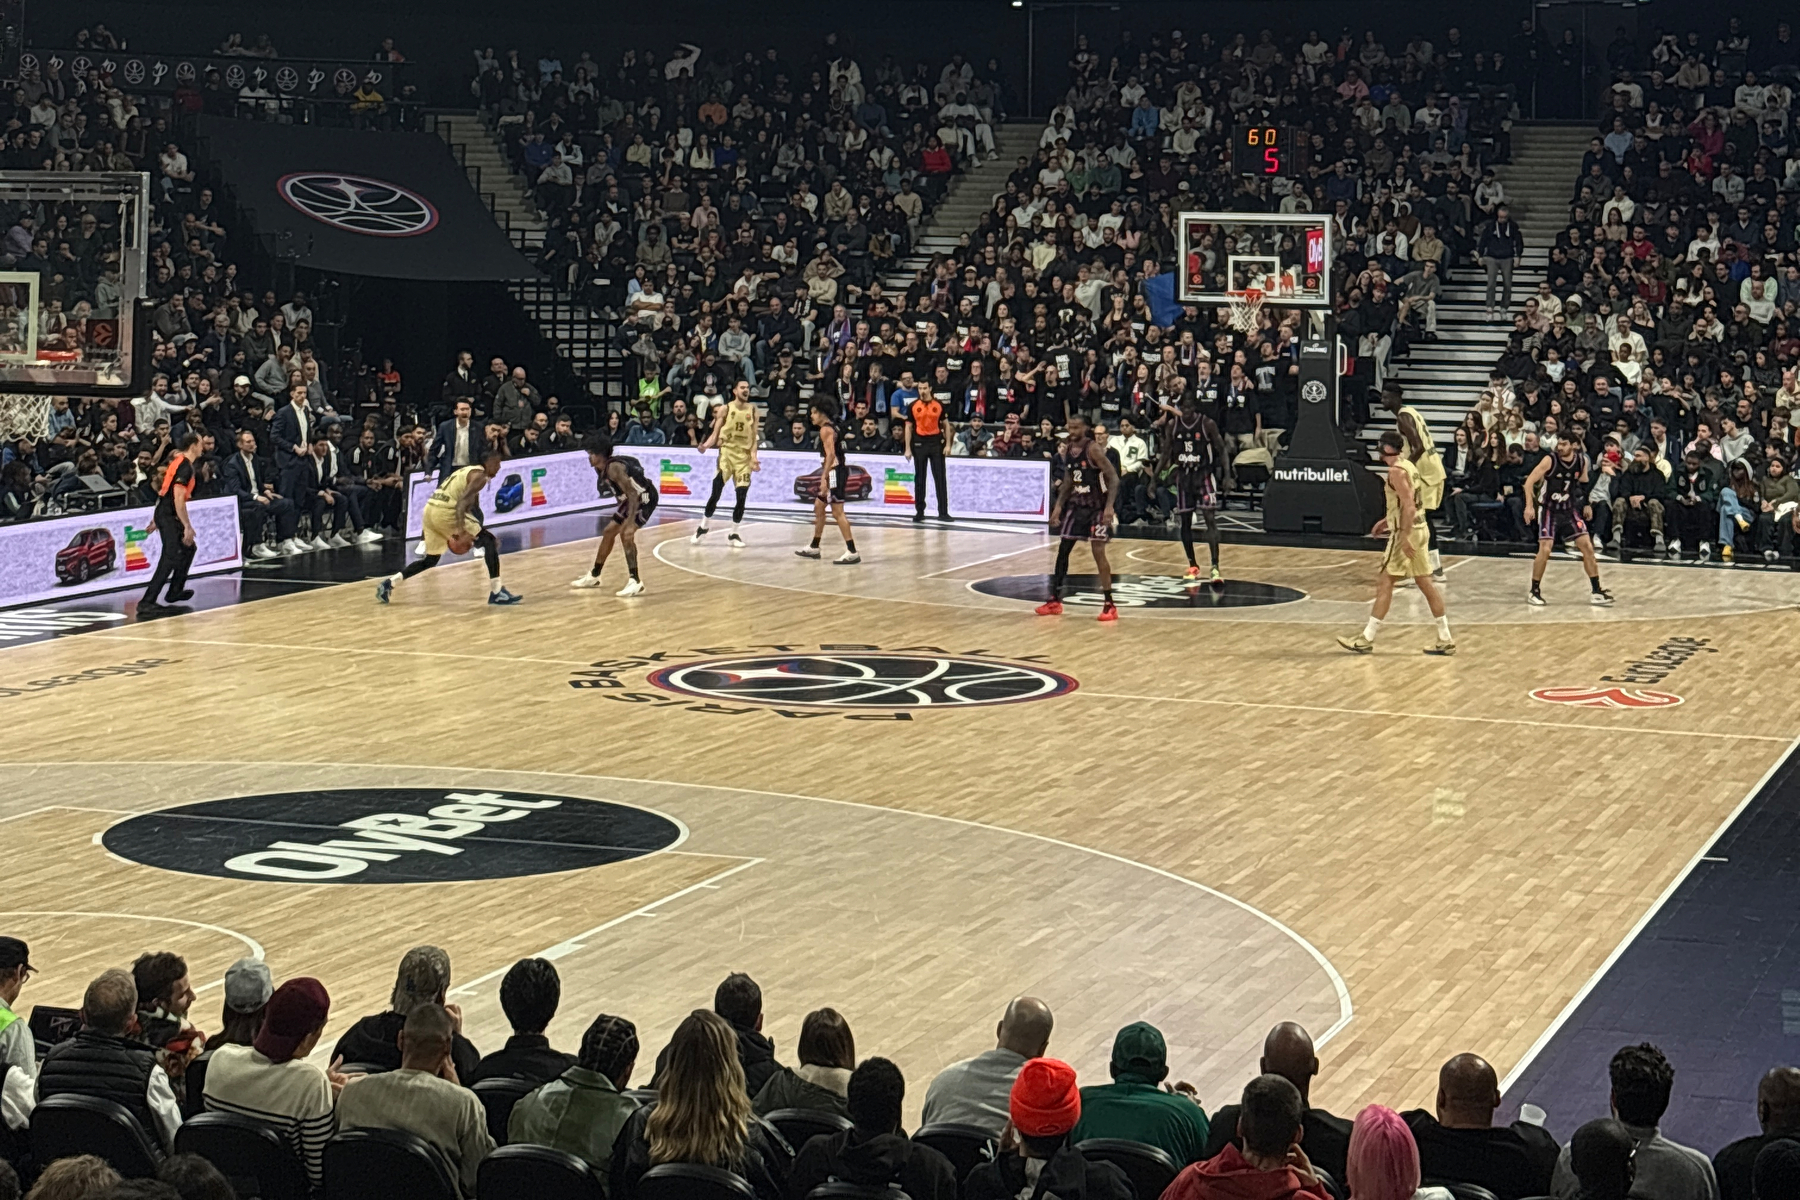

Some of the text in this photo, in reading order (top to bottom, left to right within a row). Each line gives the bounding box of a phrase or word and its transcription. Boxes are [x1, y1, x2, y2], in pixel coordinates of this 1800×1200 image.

[1264, 147, 1279, 173] 5
[735, 422, 744, 432] 13
[1126, 445, 1139, 458] P
[1183, 441, 1194, 453] 15
[1073, 469, 1083, 482] 22
[1274, 467, 1348, 483] nutribullet
[1564, 480, 1571, 492] 7
[1094, 523, 1107, 537] 22
[223, 791, 563, 881] OlyBet
